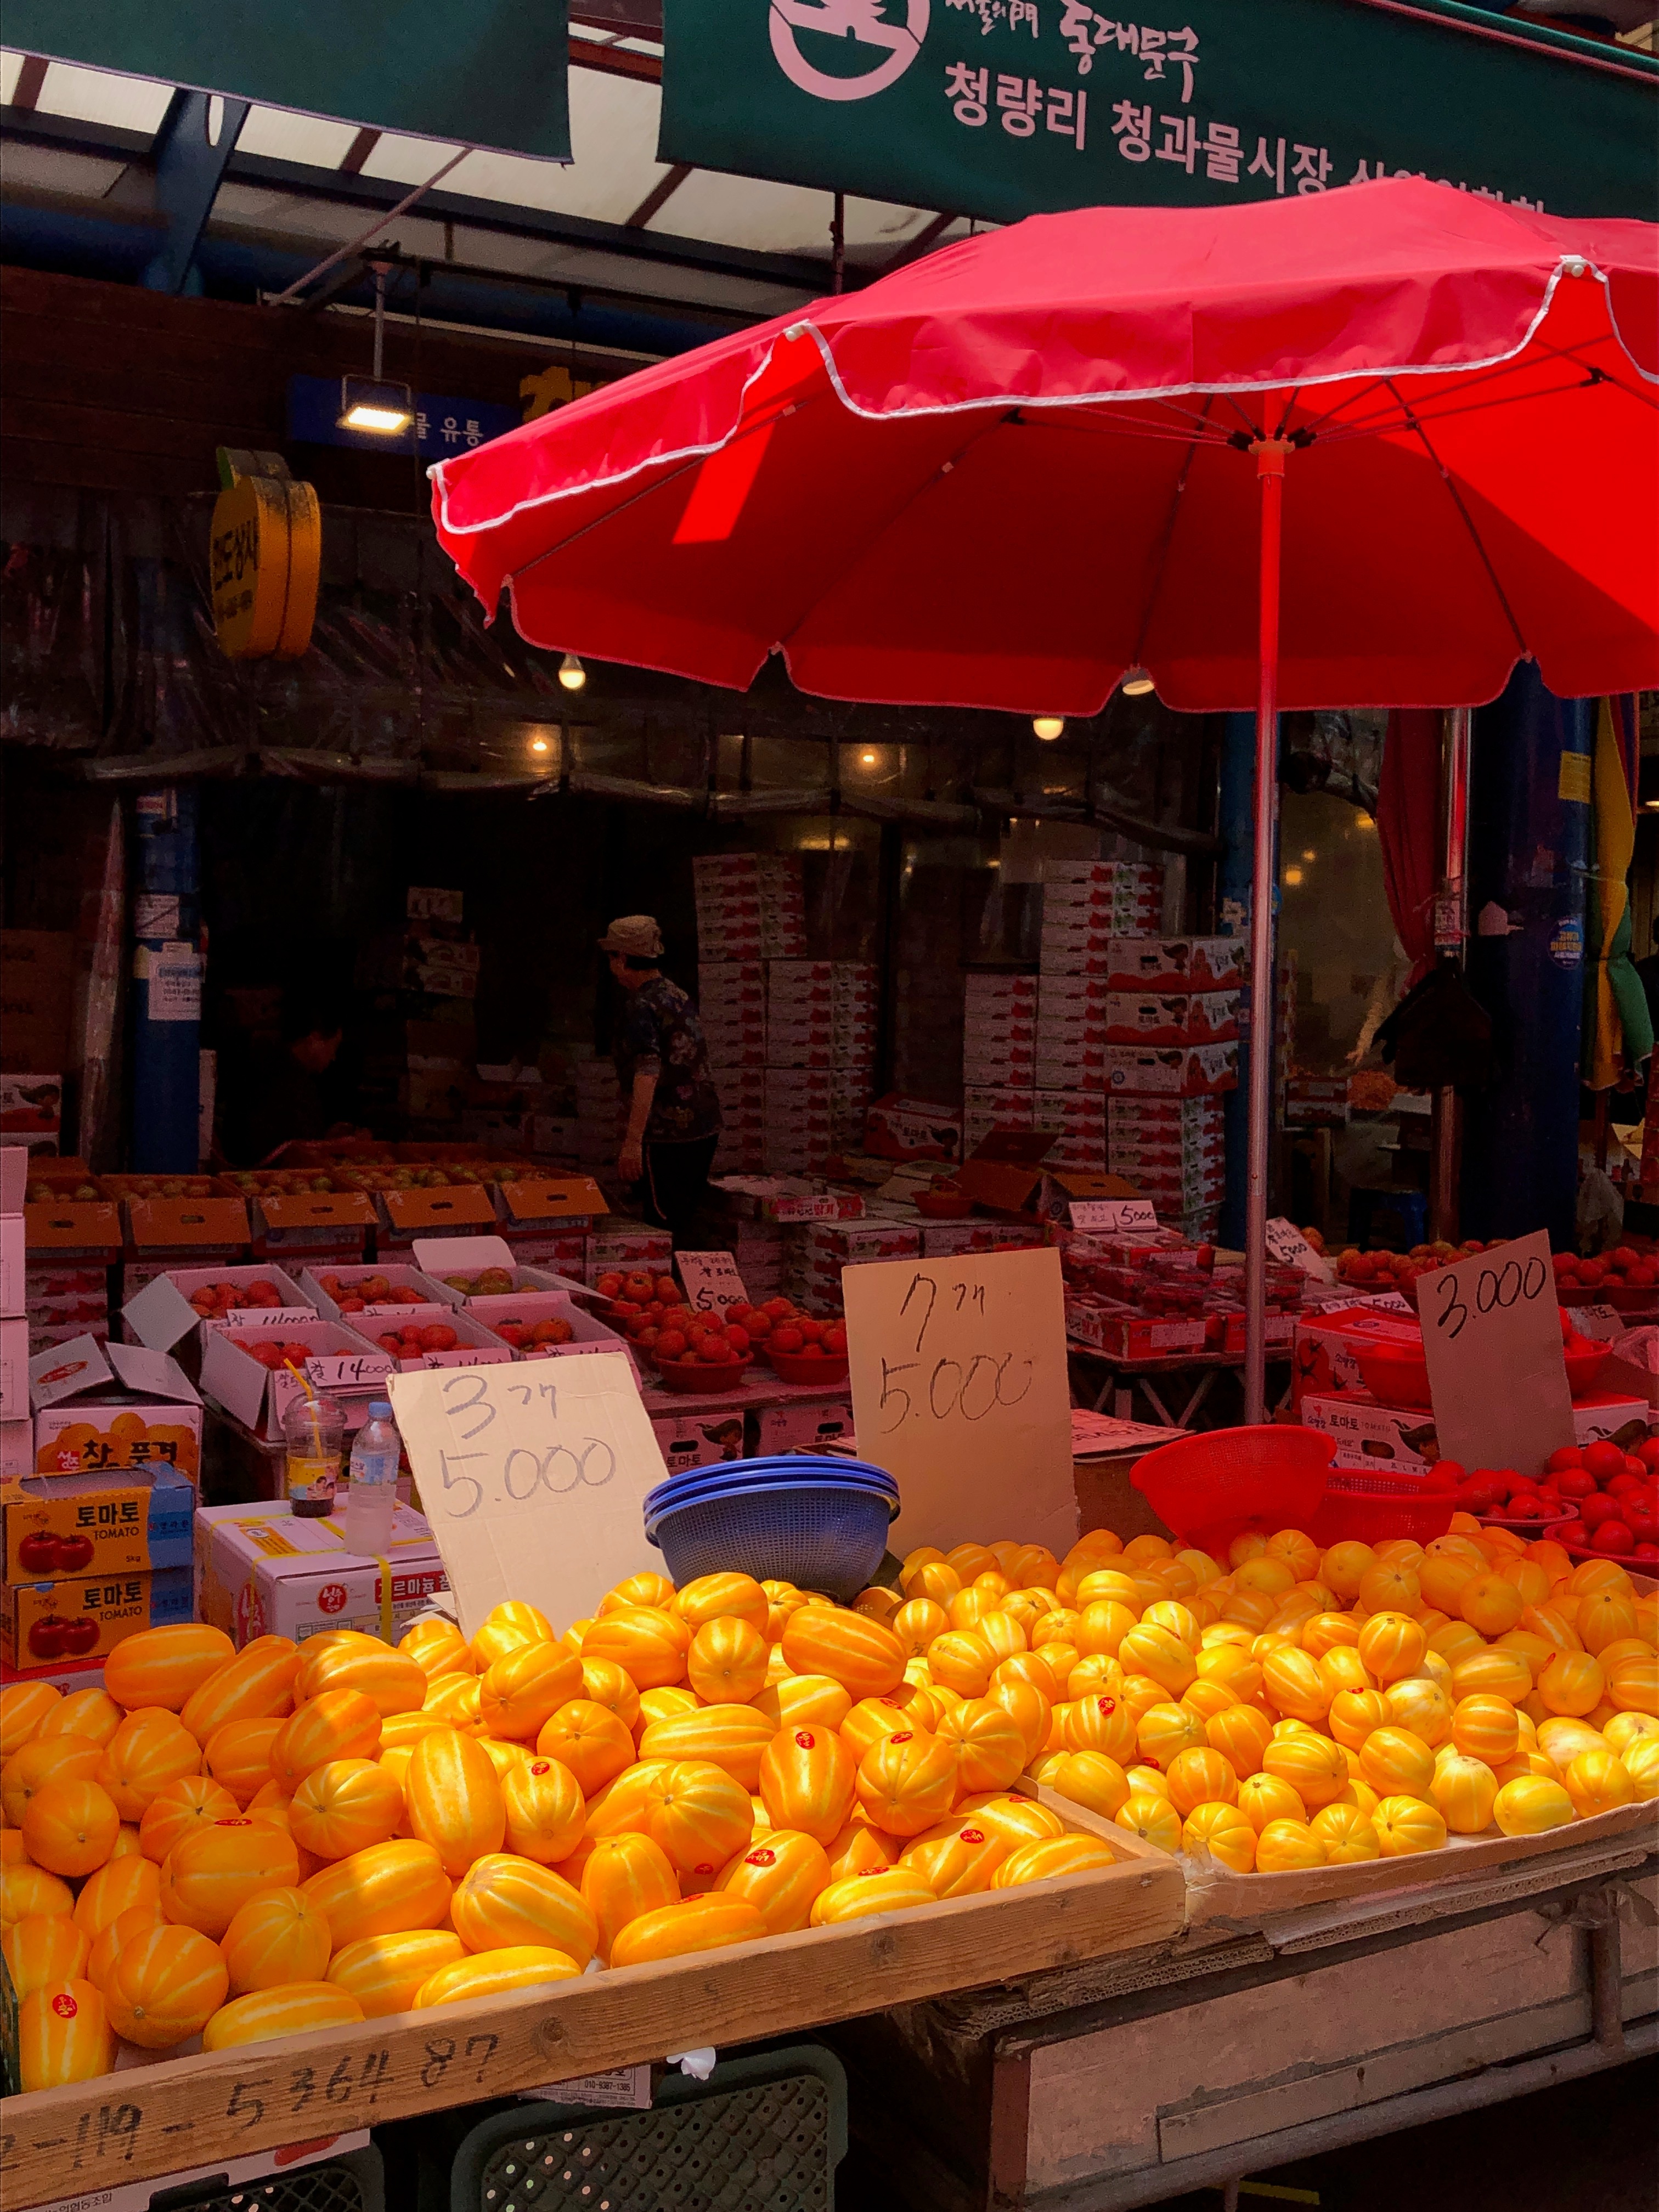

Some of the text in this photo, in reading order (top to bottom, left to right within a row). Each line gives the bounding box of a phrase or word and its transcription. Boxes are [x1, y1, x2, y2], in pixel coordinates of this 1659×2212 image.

[1059, 0, 1200, 103] 동대문구
[944, 61, 1087, 150] 청량리
[1110, 99, 1333, 196] 청과물시장
[1436, 1256, 1547, 1339] 3.000
[337, 1358, 393, 1381] 14000
[879, 1352, 1034, 1434] 5.000
[1329, 1414, 1359, 1430] 토마토
[667, 1454, 702, 1468] 토마토
[438, 1437, 616, 1518] 5.000
[76, 1502, 140, 1528] 토마토
[94, 1527, 140, 1541] TOMATO
[83, 1581, 143, 1611] 토마토
[378, 1577, 435, 1599] 르마늄
[99, 1605, 143, 1622] TOMATO
